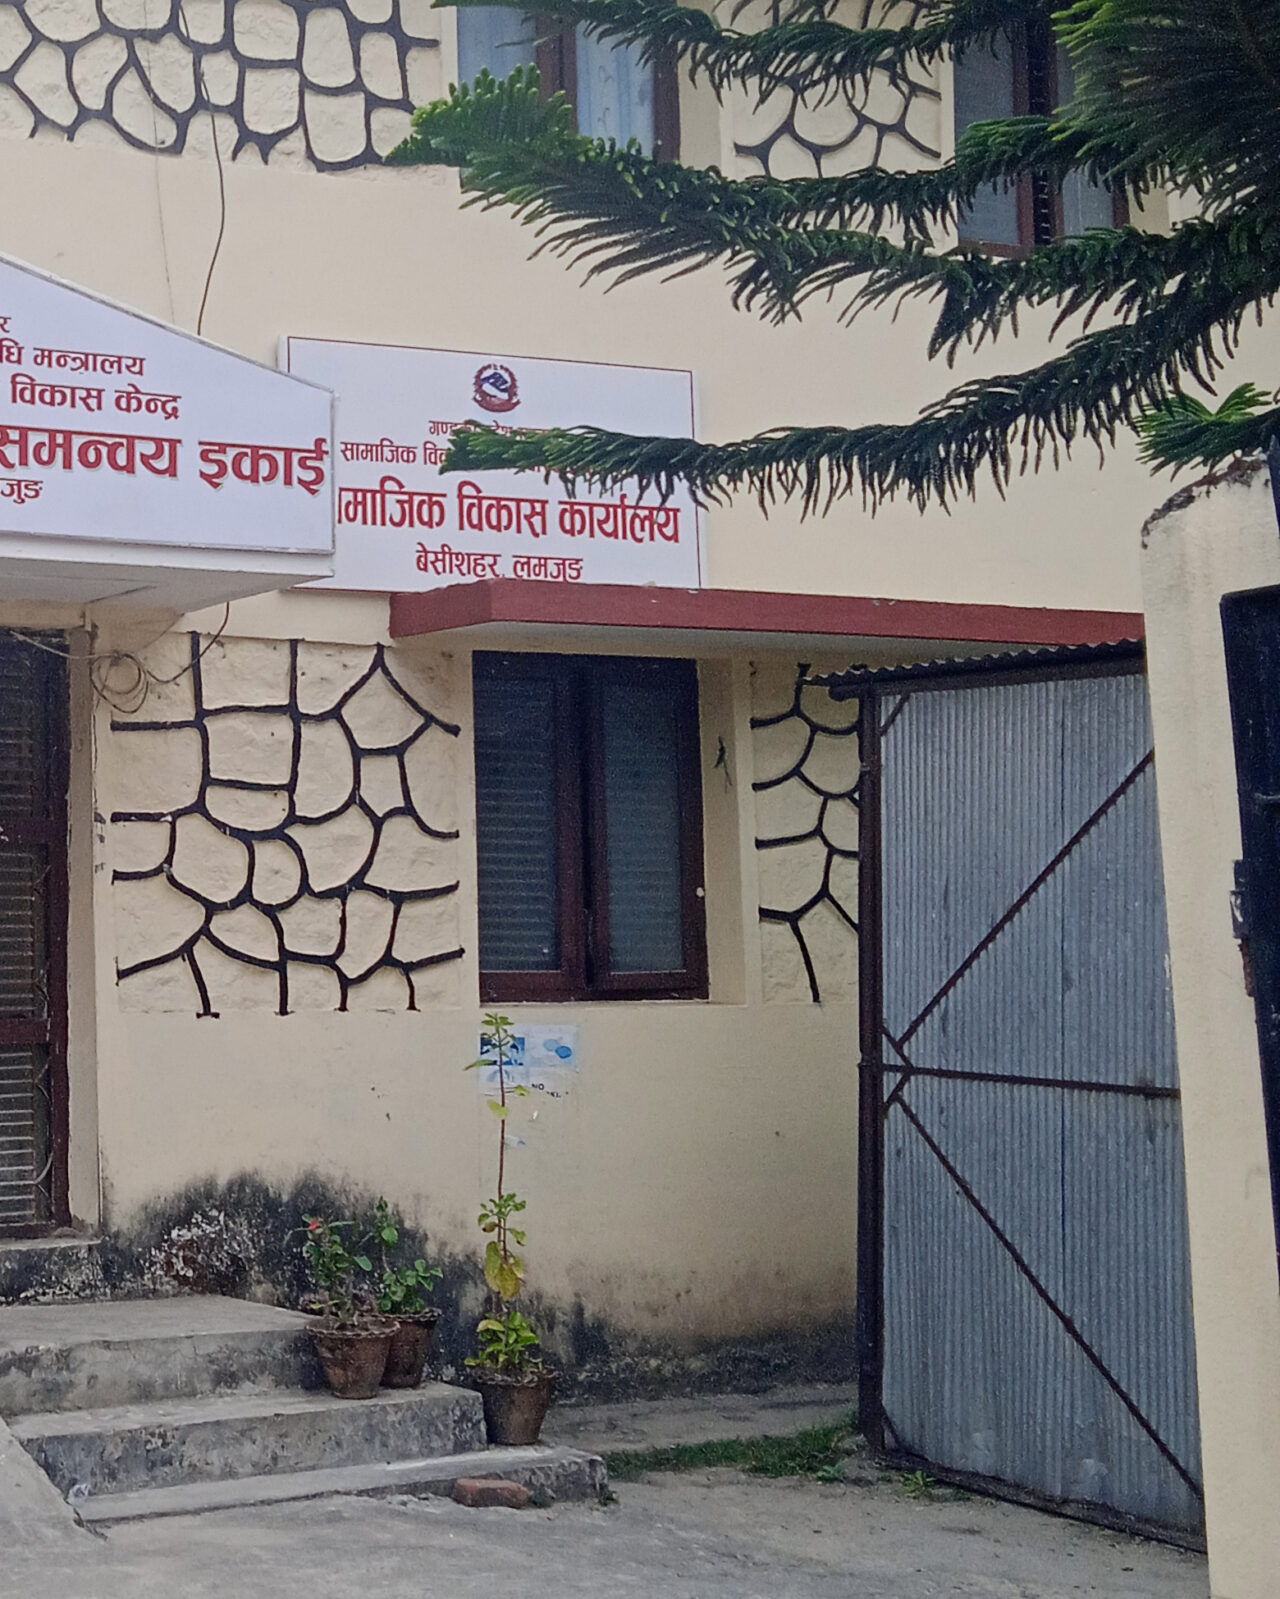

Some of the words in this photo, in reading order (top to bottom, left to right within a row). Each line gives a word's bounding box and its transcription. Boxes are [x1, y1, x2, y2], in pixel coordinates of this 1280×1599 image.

[32, 347, 146, 377] मन्त्रालय
[10, 372, 105, 413] विकास
[114, 382, 182, 421] केन्द्र
[198, 437, 330, 496] इकाई
[340, 438, 417, 464] सामाजिक
[456, 479, 549, 539] विकास
[558, 493, 682, 545] कार्यालय
